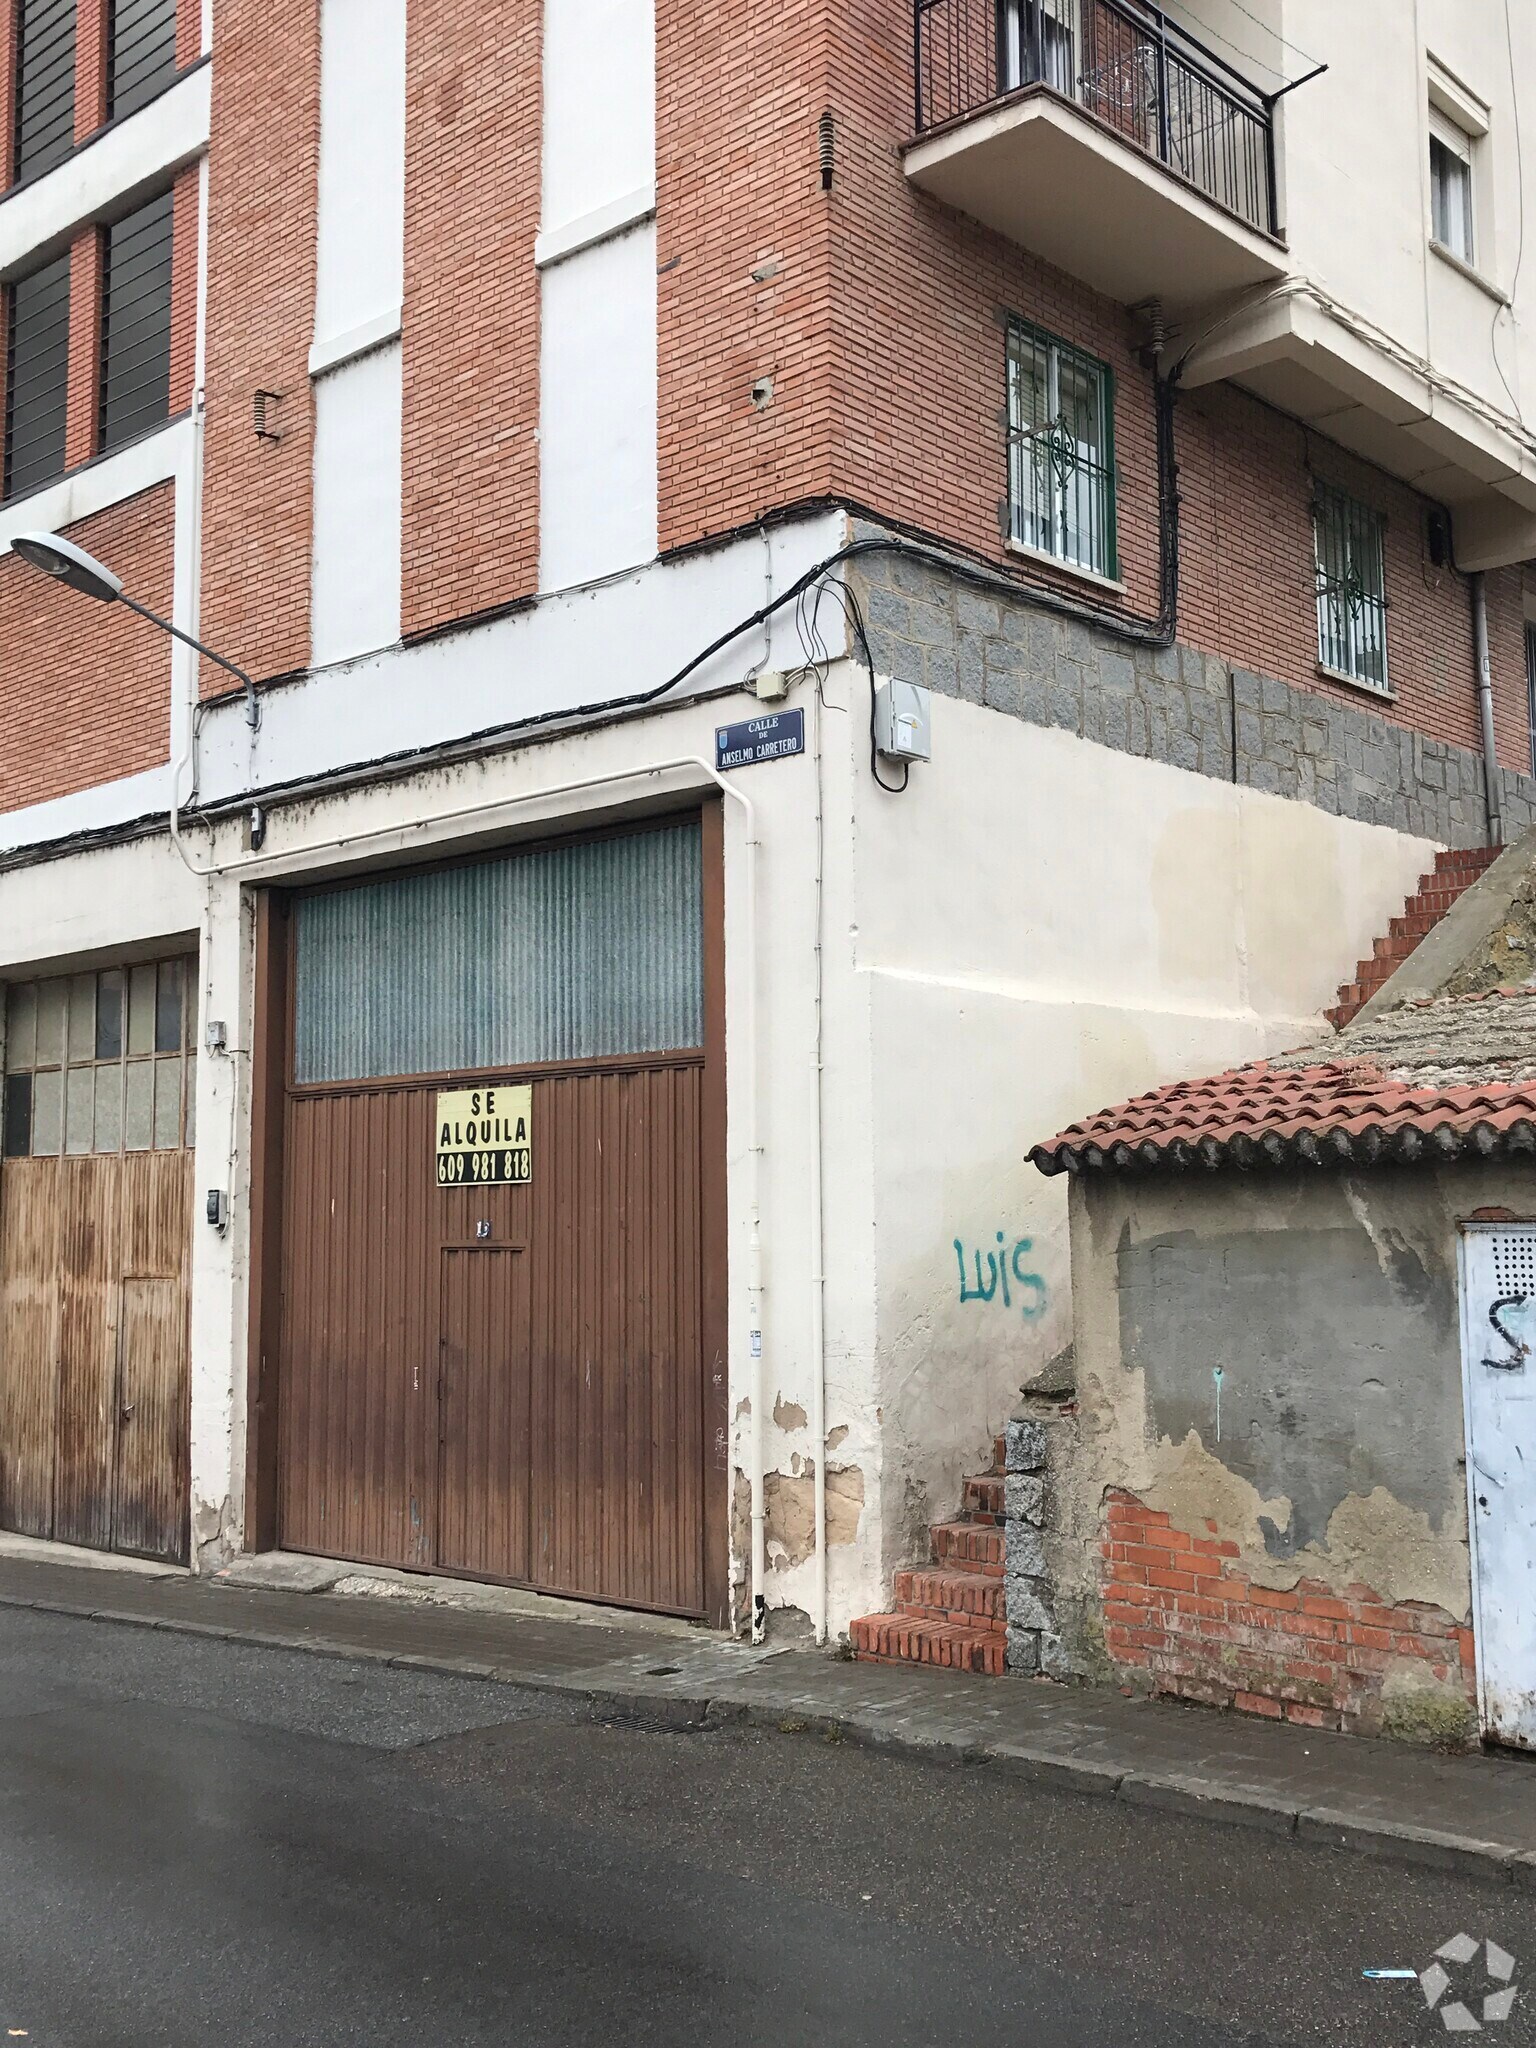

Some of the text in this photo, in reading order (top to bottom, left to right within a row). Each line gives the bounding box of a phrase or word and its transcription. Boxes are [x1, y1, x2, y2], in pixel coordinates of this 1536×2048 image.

[748, 717, 779, 733] CALLE
[758, 731, 768, 739] DE
[721, 737, 797, 766] ANSELMO CARRETERO
[471, 1091, 495, 1116] SE
[440, 1117, 526, 1147] ALQUILA
[439, 1150, 529, 1182] 609 981 818
